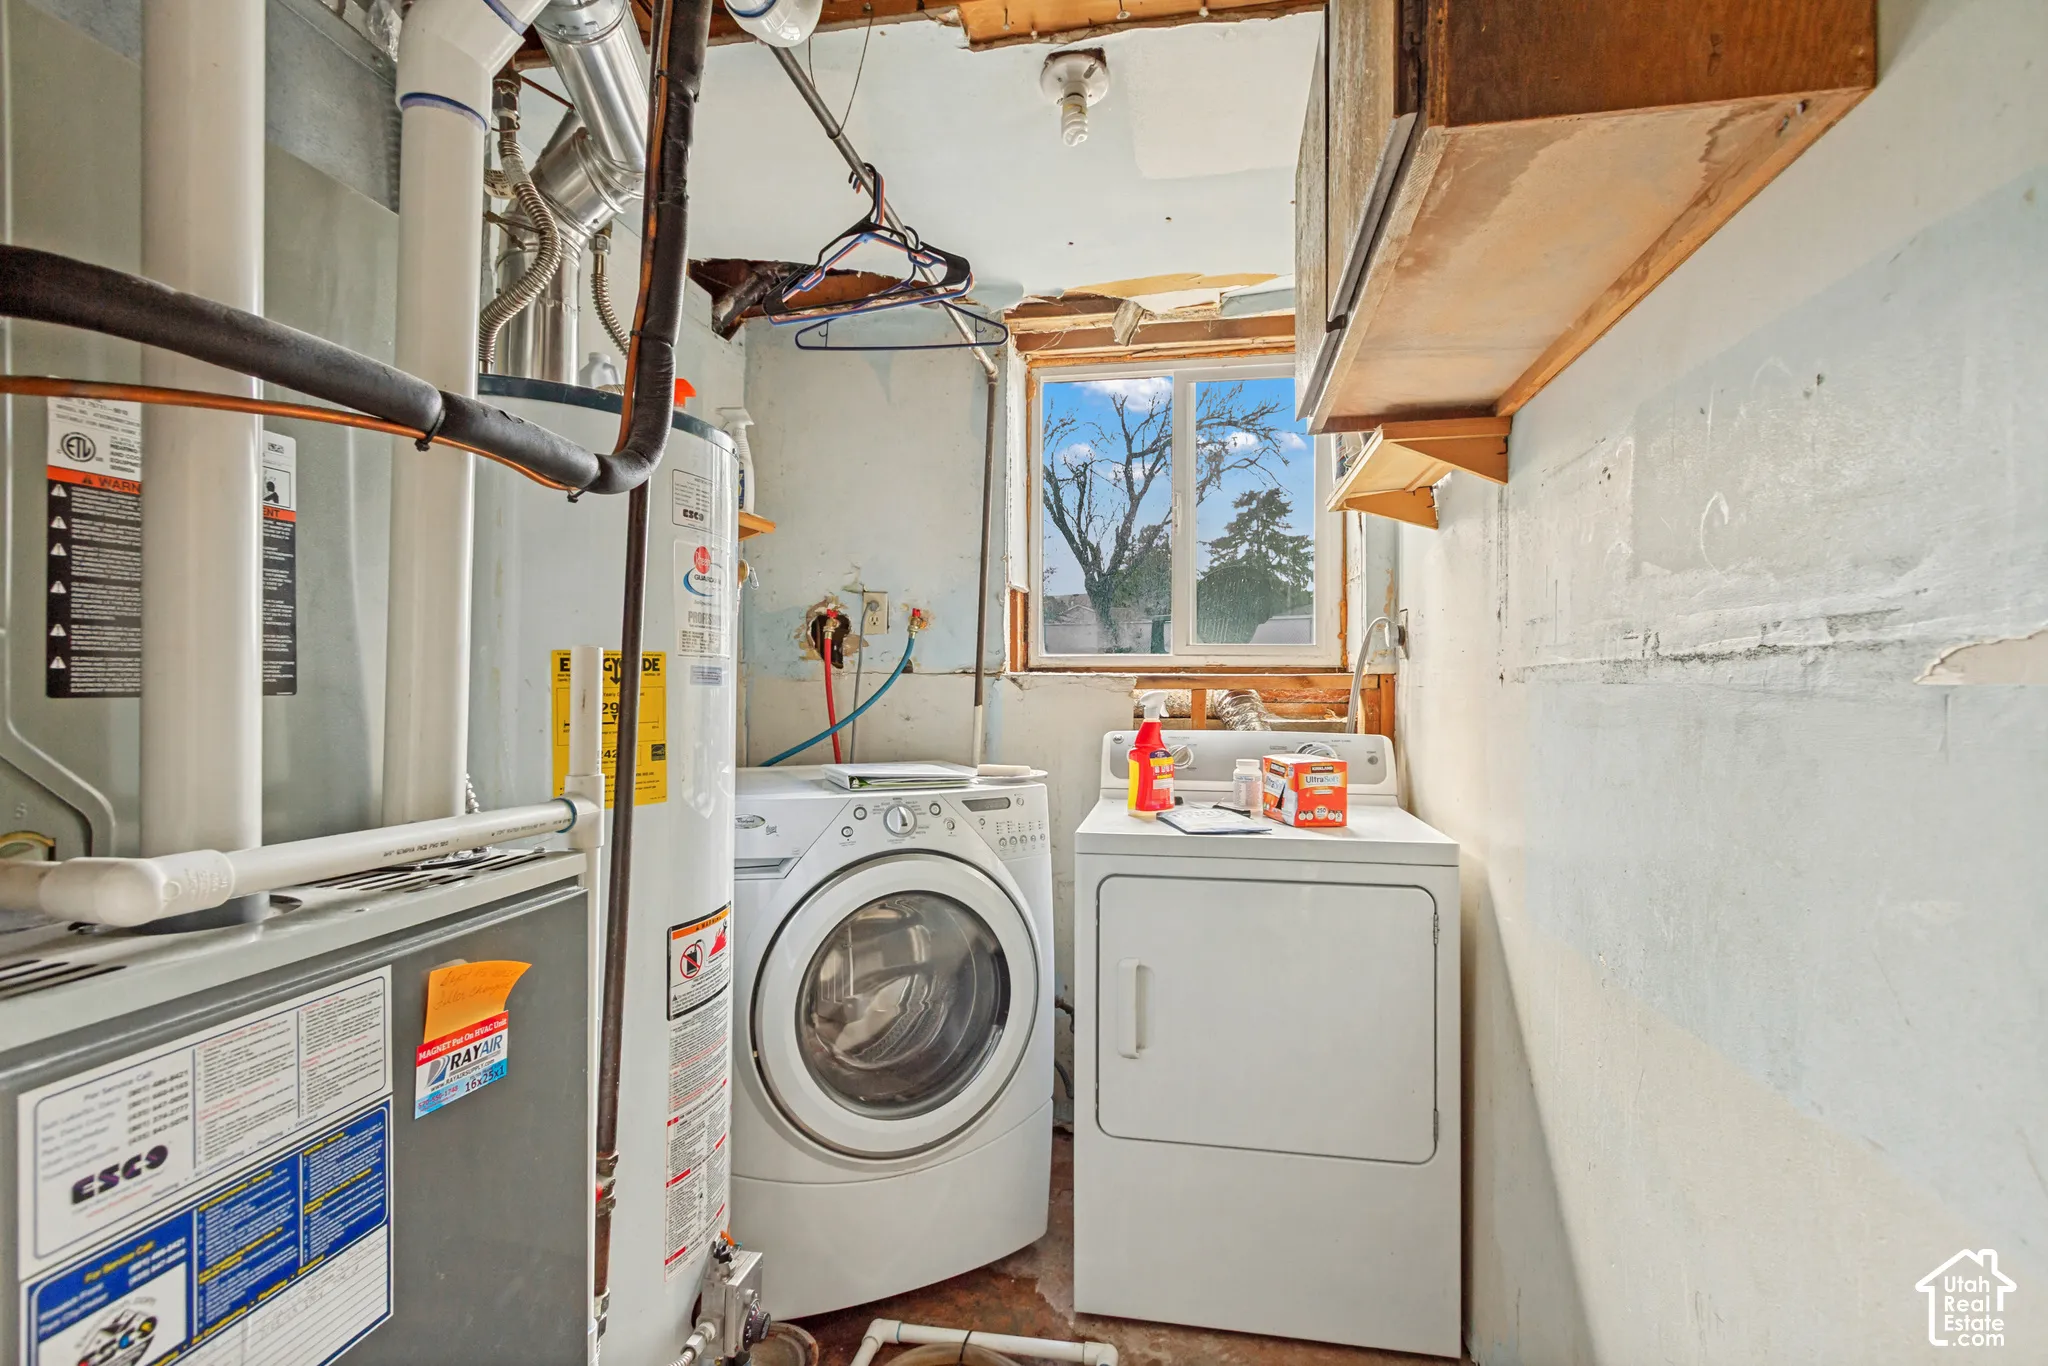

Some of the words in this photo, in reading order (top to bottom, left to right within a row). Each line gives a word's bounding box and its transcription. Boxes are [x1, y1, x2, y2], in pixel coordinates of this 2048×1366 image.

[67, 436, 91, 458] ETL
[419, 1041, 451, 1060] MAGNET
[452, 1037, 464, 1046] Put
[464, 1032, 474, 1040] On
[474, 1023, 493, 1037] HVAC
[493, 1018, 507, 1028] Unit
[465, 1065, 504, 1093] 16x25x1
[71, 1145, 168, 1204] ESCO
